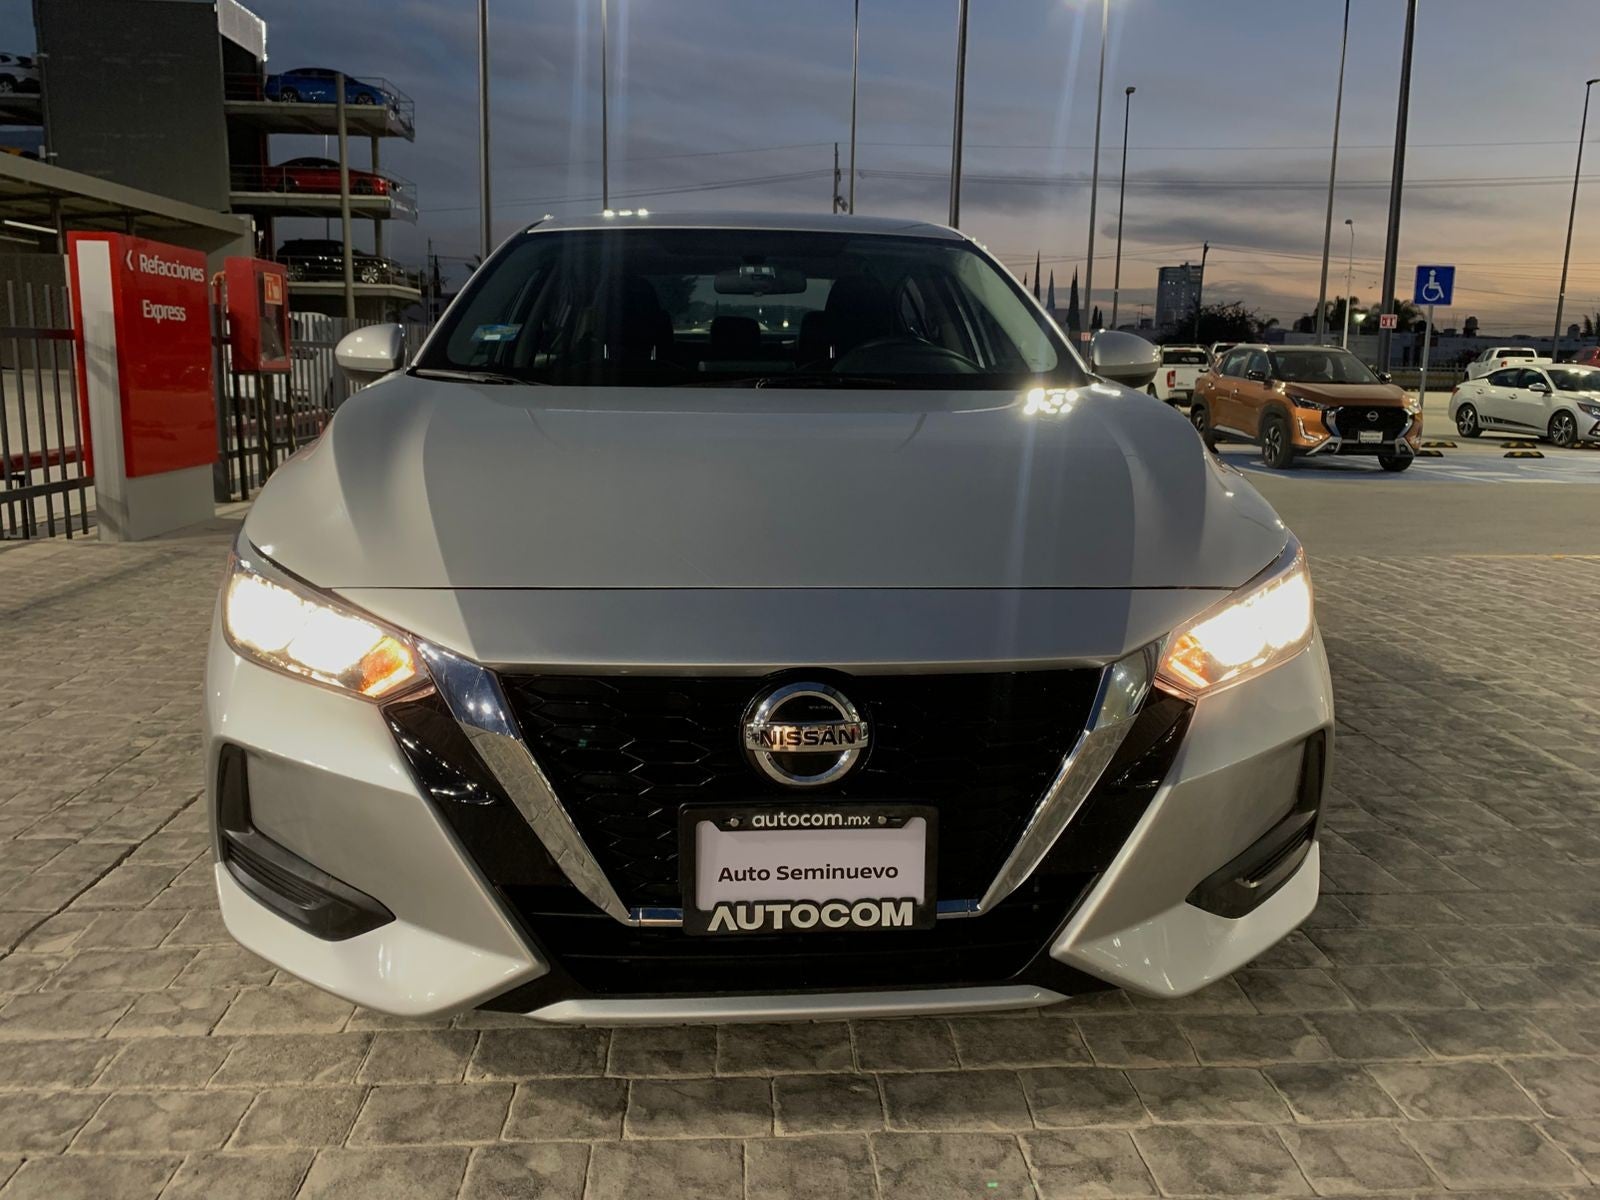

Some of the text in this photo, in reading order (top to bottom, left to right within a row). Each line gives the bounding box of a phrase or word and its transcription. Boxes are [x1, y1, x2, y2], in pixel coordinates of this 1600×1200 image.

[139, 254, 205, 282] Refacciones
[142, 299, 187, 324] Express
[759, 727, 856, 746] NISSAN
[752, 812, 871, 828] autocom.mx
[718, 864, 899, 883] Auto Seminuevo
[707, 901, 914, 932] AUTOCOM
